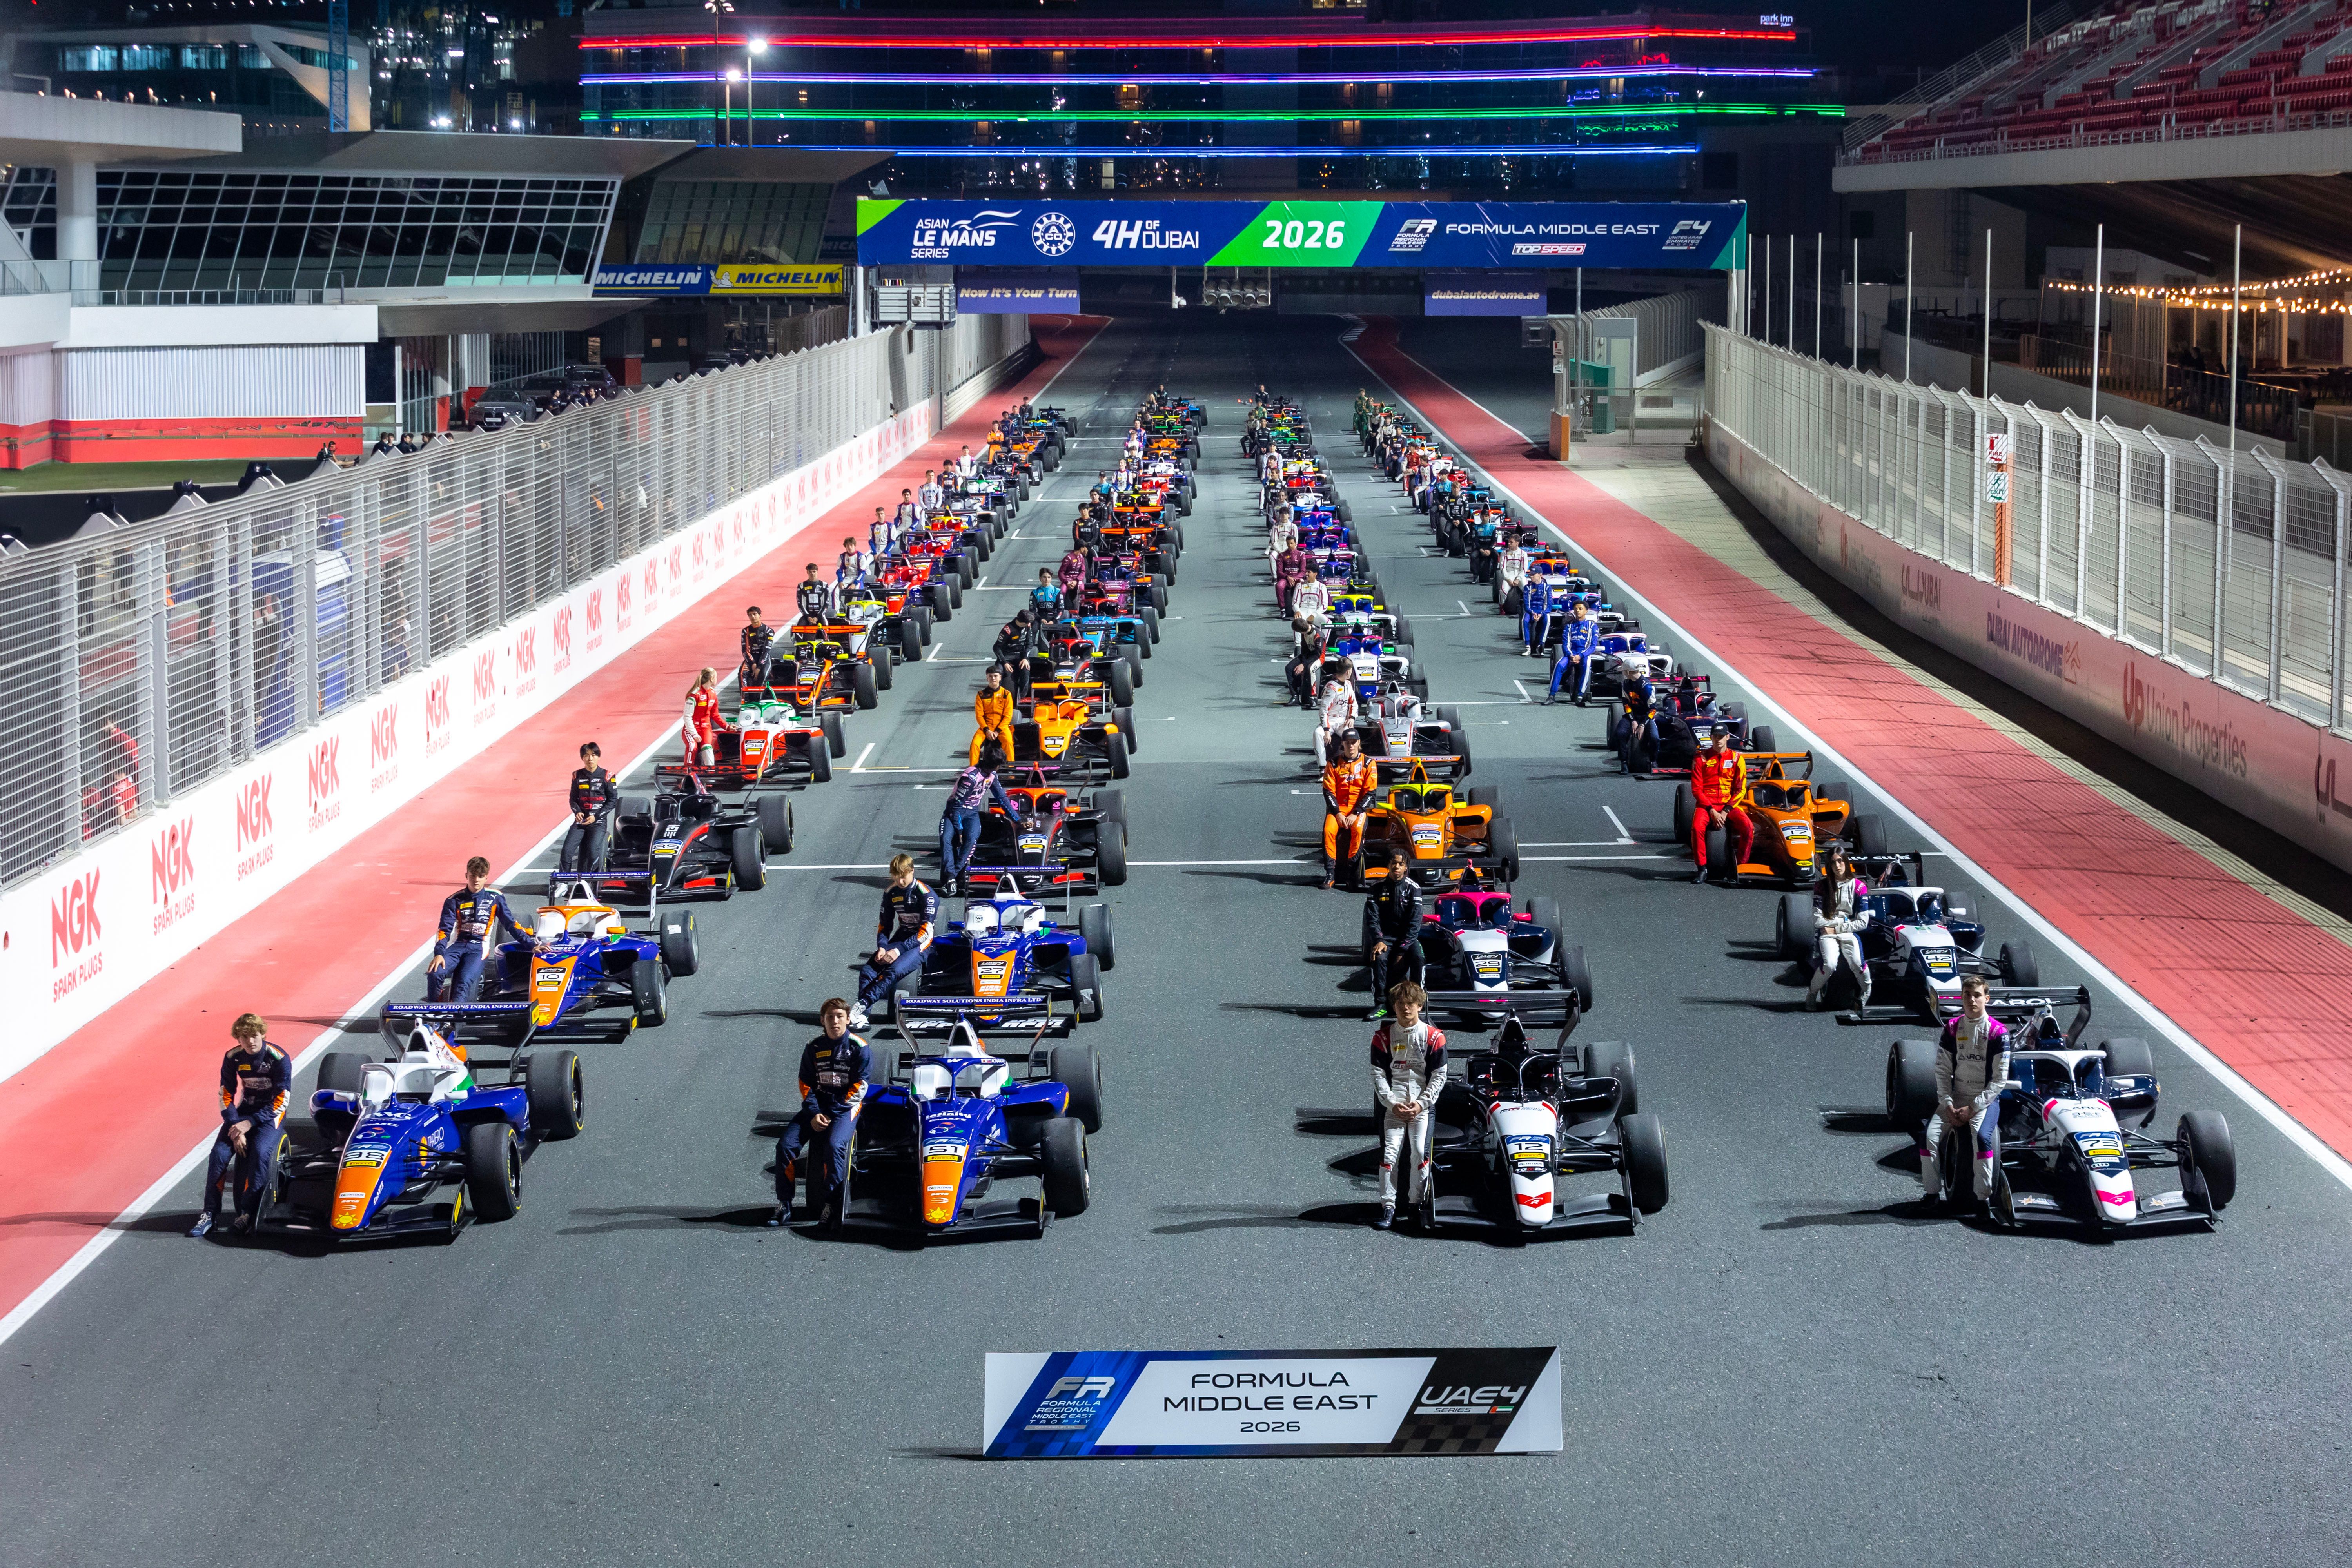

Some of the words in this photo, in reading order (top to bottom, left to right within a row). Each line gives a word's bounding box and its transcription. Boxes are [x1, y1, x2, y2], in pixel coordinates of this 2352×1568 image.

[1760, 14, 1778, 25] park
[1780, 14, 1793, 23] inn
[913, 230, 936, 246] LE
[941, 230, 996, 246] MANS
[916, 219, 949, 229] ASIAN
[1092, 220, 1143, 248] 4H
[1145, 220, 1160, 229] OF
[1262, 220, 1345, 248] 2026
[1446, 224, 1535, 234] FORMULA
[1539, 225, 1607, 234] MIDDLE
[1612, 225, 1660, 234] EAST
[1671, 220, 1712, 235] F4
[911, 248, 949, 258] SERIES
[1143, 231, 1199, 248] DUBAI
[595, 272, 702, 284] MICHELIN
[736, 272, 839, 284] MICHELIN
[960, 288, 989, 298] Now
[1015, 288, 1045, 298] Your
[1048, 288, 1077, 298] Turn
[1432, 290, 1540, 299] dubaiautodrome.ae
[670, 543, 681, 584] NGK
[645, 557, 657, 599] NGK
[617, 571, 631, 621] NGK
[554, 604, 570, 656] NGK
[516, 626, 535, 679] NGK
[1987, 612, 2010, 652] DUBAI
[2012, 624, 2063, 679] AUTODROME
[474, 647, 495, 706] NGK
[426, 673, 450, 736] NGK
[372, 701, 397, 769] NGK
[2147, 684, 2179, 750] Union
[2183, 701, 2247, 778] Properties
[309, 732, 339, 808] NGK
[237, 771, 272, 853] NGK
[152, 814, 194, 904] NGK
[238, 854, 255, 882] SPARK
[256, 843, 273, 870] PLUGS
[52, 865, 101, 969] NGK
[154, 906, 173, 936] SPARK
[175, 893, 194, 922] PLUGS
[54, 967, 77, 1003] SPARK
[79, 951, 102, 986] PLUGS
[344, 1152, 385, 1160] 98
[1045, 1376, 1115, 1399] FR
[1191, 1373, 1350, 1388] FORMULA
[1164, 1396, 1289, 1412] MIDDLE
[1294, 1394, 1377, 1411] EAST
[1421, 1386, 1527, 1405] UAE4
[1240, 1421, 1301, 1433] 2026
